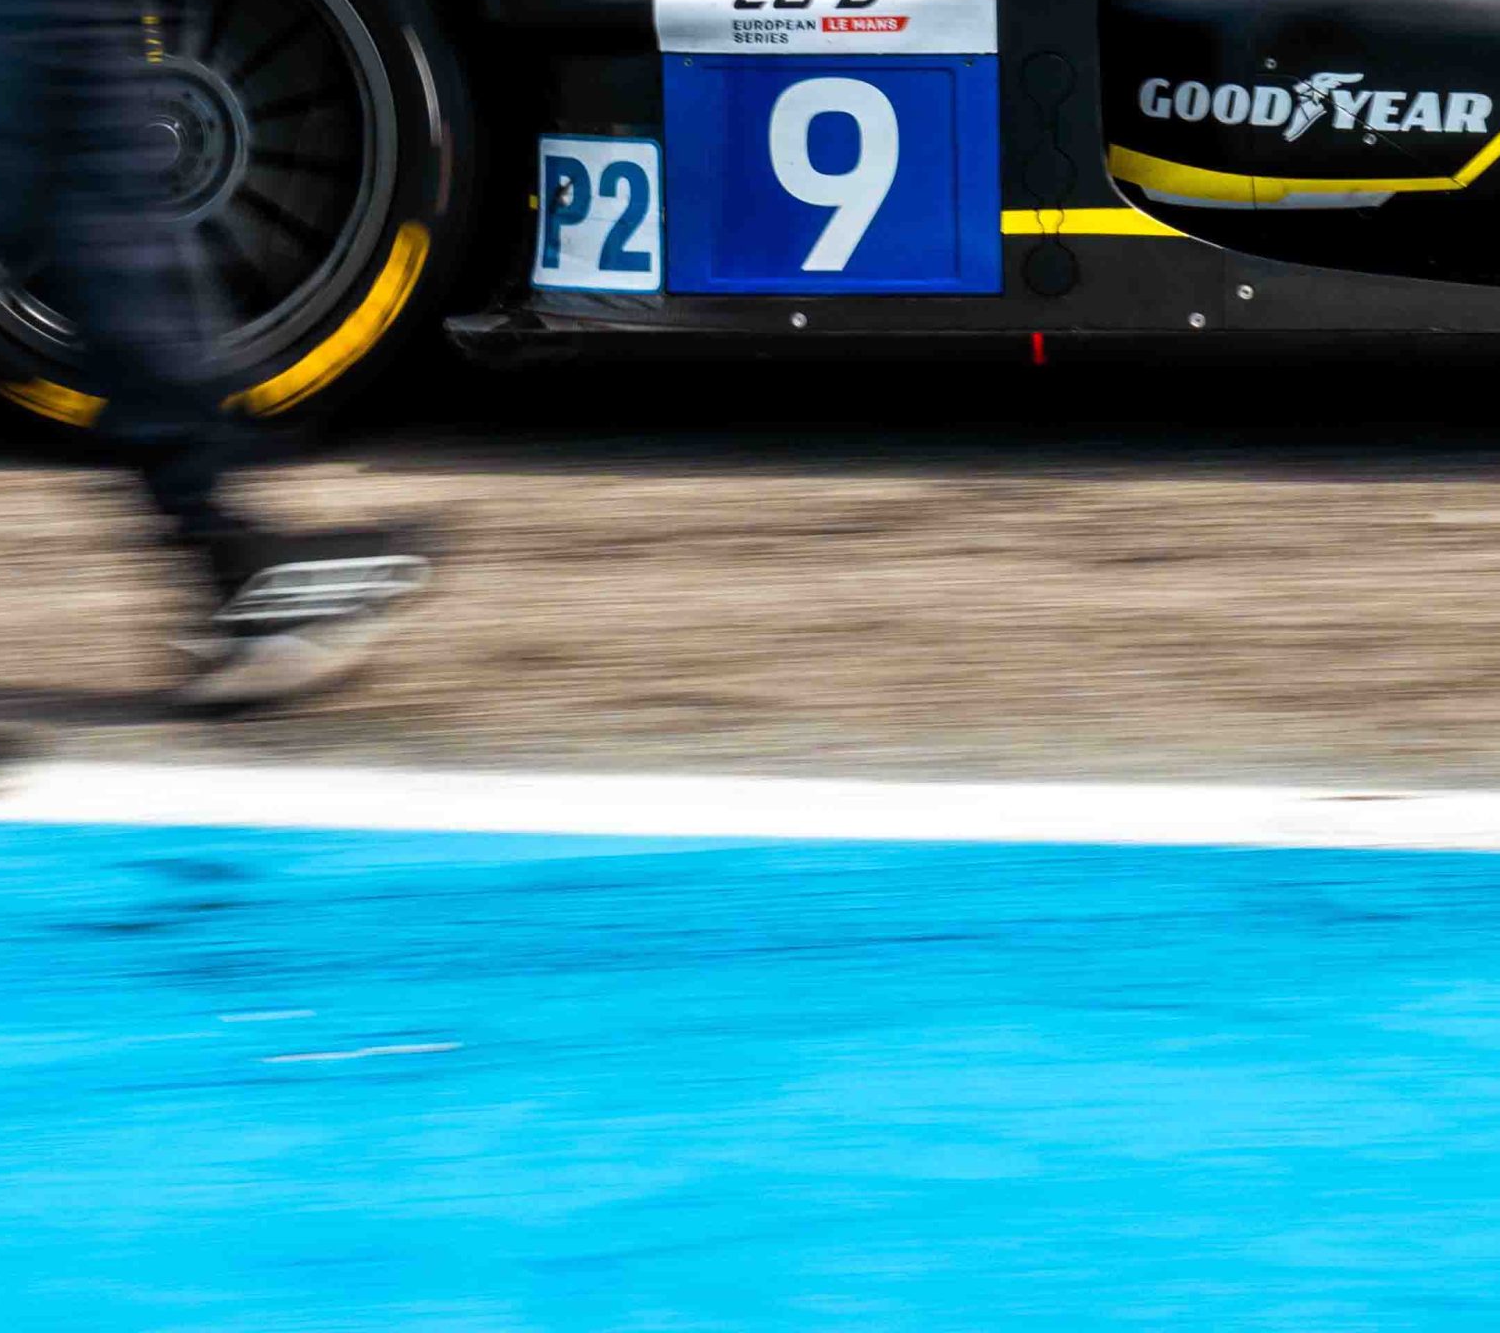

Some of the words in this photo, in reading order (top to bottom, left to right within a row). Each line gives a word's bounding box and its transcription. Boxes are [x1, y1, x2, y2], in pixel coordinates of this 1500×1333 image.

[733, 19, 816, 32] EUROPEAN
[829, 17, 848, 32] LE
[851, 17, 898, 32] MANS
[733, 33, 789, 44] SERIES
[1139, 72, 1493, 141] GOODYEAR
[769, 77, 899, 271] 9
[542, 154, 652, 271] P2
